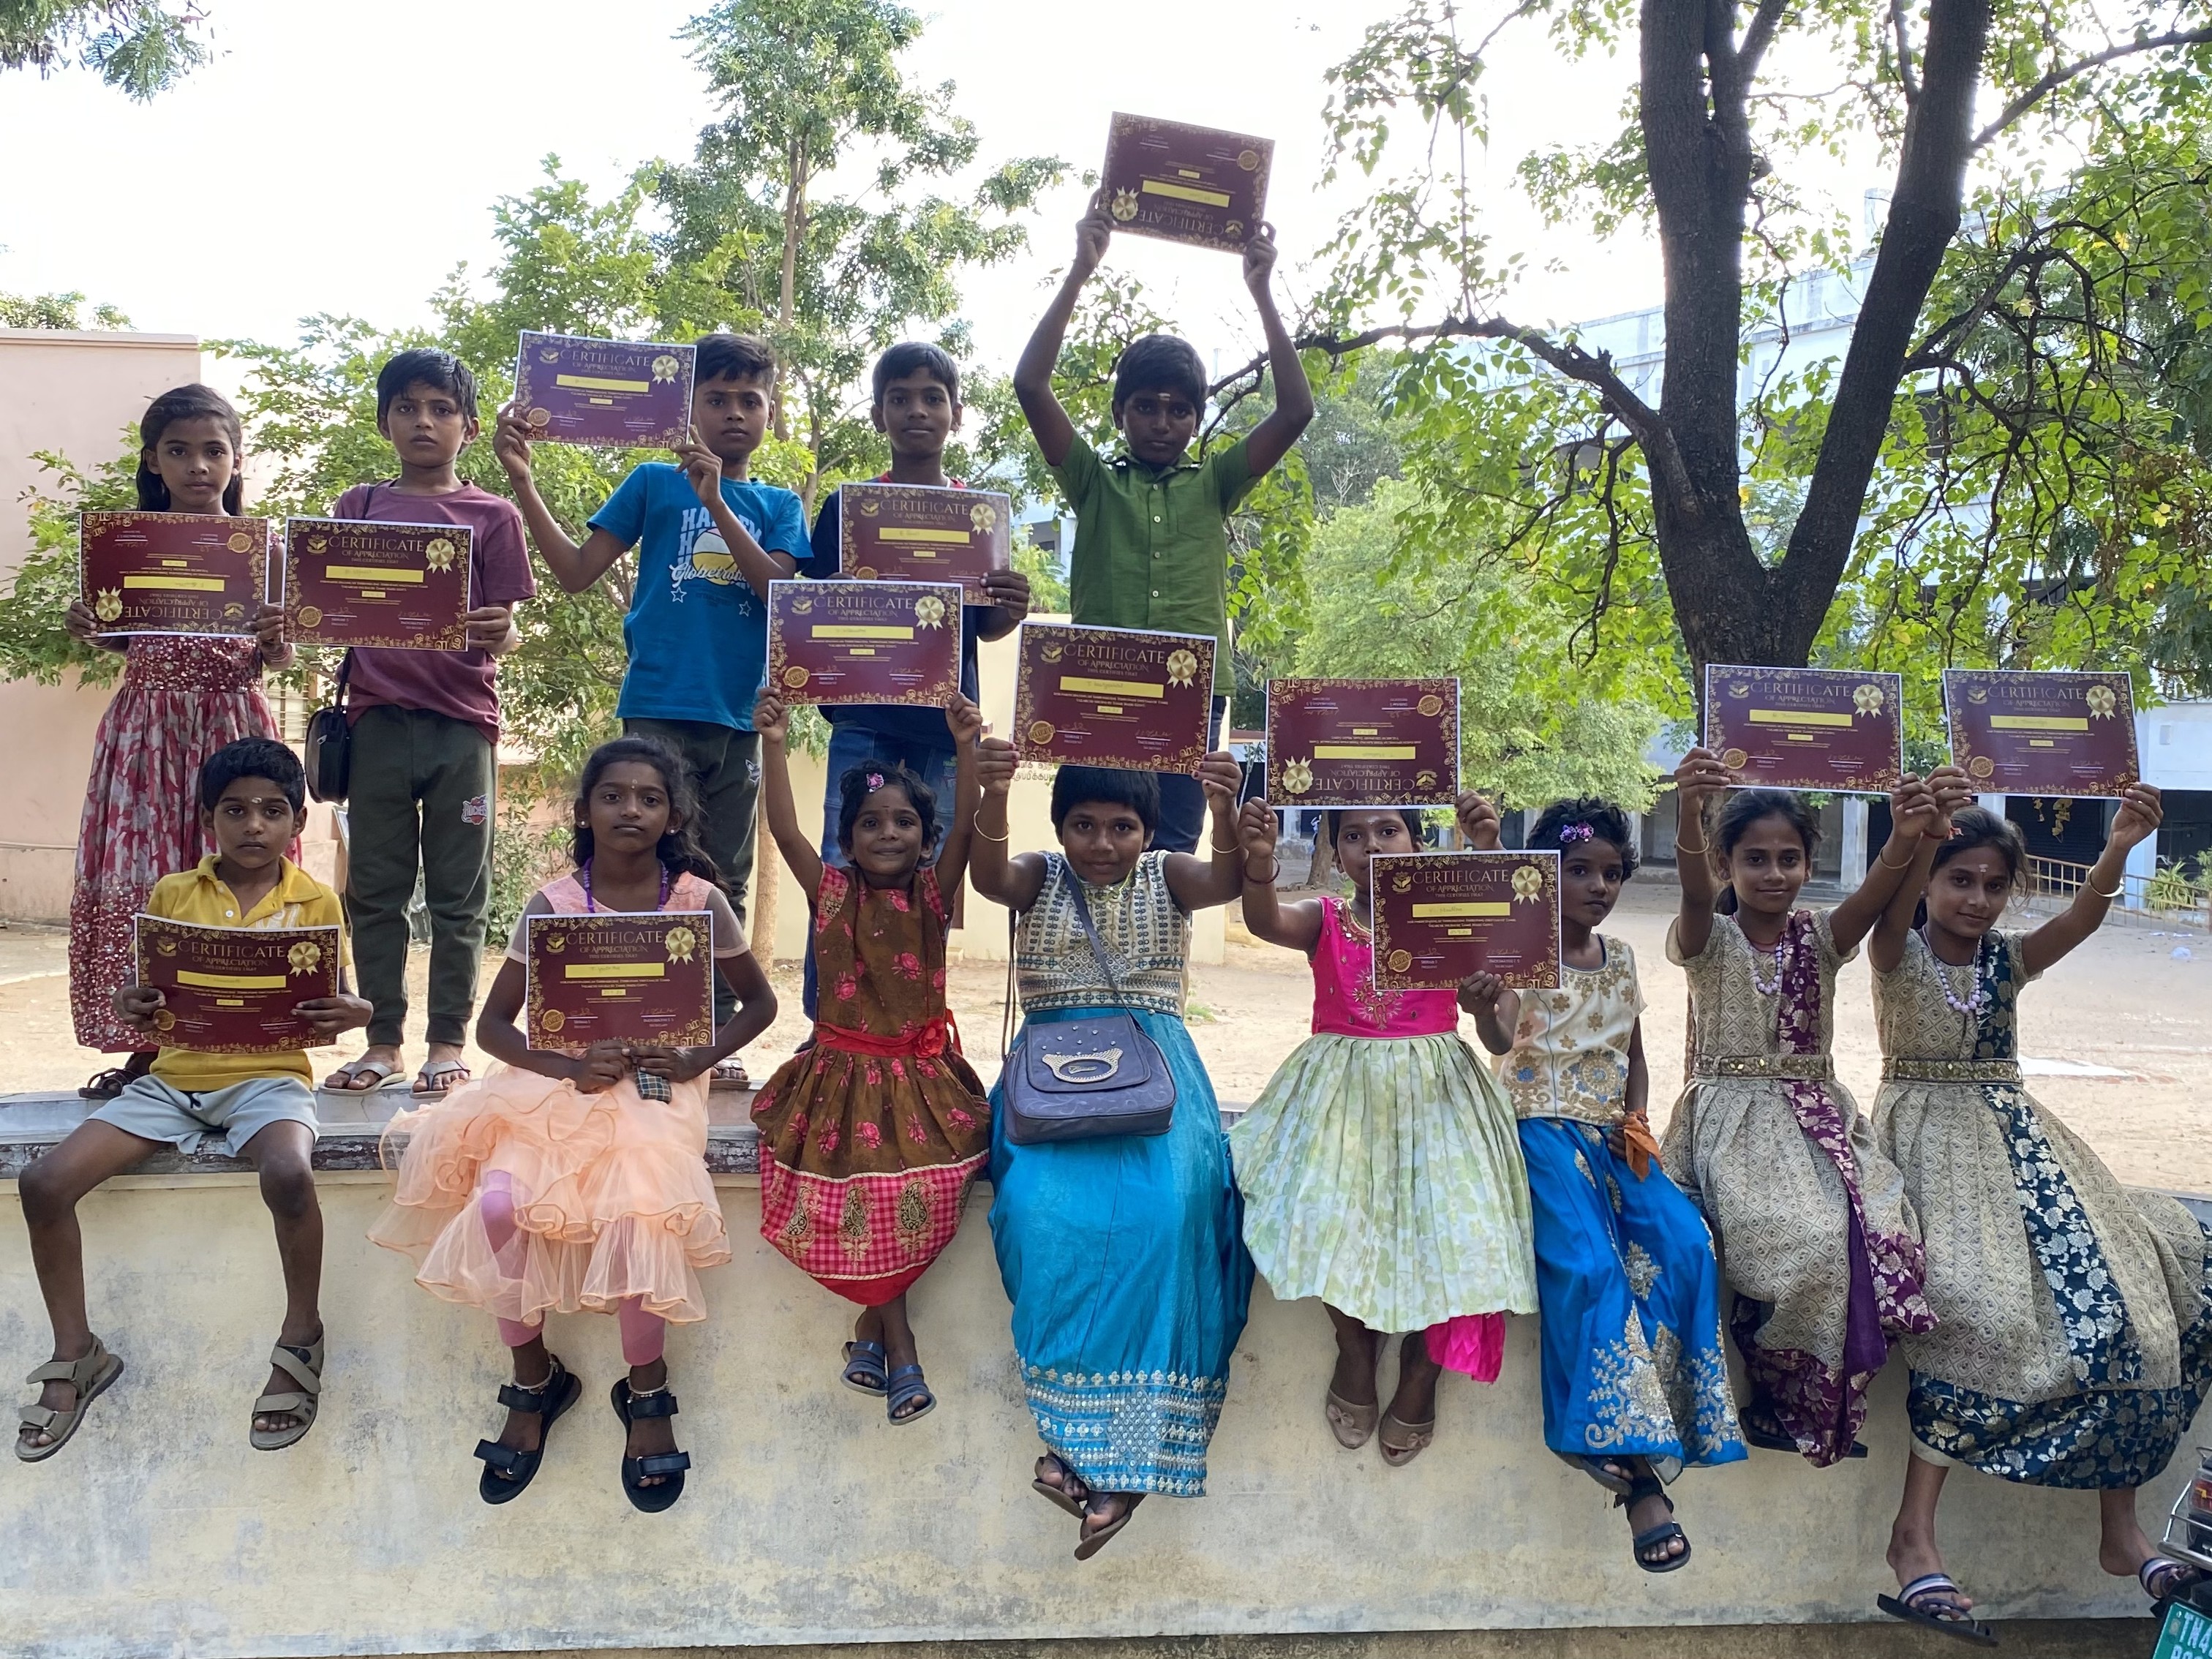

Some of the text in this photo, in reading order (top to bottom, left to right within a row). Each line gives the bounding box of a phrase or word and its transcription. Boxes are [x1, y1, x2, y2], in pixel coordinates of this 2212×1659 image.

[1137, 210, 1224, 236] CERTIFICATE
[560, 349, 651, 366] CERTIFICATE
[881, 498, 968, 515] CERTIFICATE
[681, 507, 761, 543] HAEM
[328, 535, 424, 552] CERTIFICATE
[355, 550, 410, 560] APPRECIATION
[139, 598, 195, 607] APPRECIATION
[813, 596, 913, 609] CERTIFICATE
[124, 606, 222, 621] CERTIFICATE
[841, 609, 898, 617] APPRECIATION
[1064, 644, 1165, 664] CERTIFICATE
[1091, 659, 1150, 673] APPRECIATION
[1750, 681, 1851, 697] CERTIFICATE
[1987, 685, 2084, 699] CERTIFICATE
[1329, 769, 1387, 777] APPRECIATION
[1315, 778, 1415, 791] CERTIFICATE
[1412, 870, 1509, 884] CERTIFICATE
[1439, 883, 1495, 893] APPRECIATION
[565, 930, 663, 946] CERTIFICATE
[178, 941, 285, 958] CERTIFICATE
[592, 944, 649, 955] APPRECIATION
[206, 958, 269, 967] APPRECIATION
